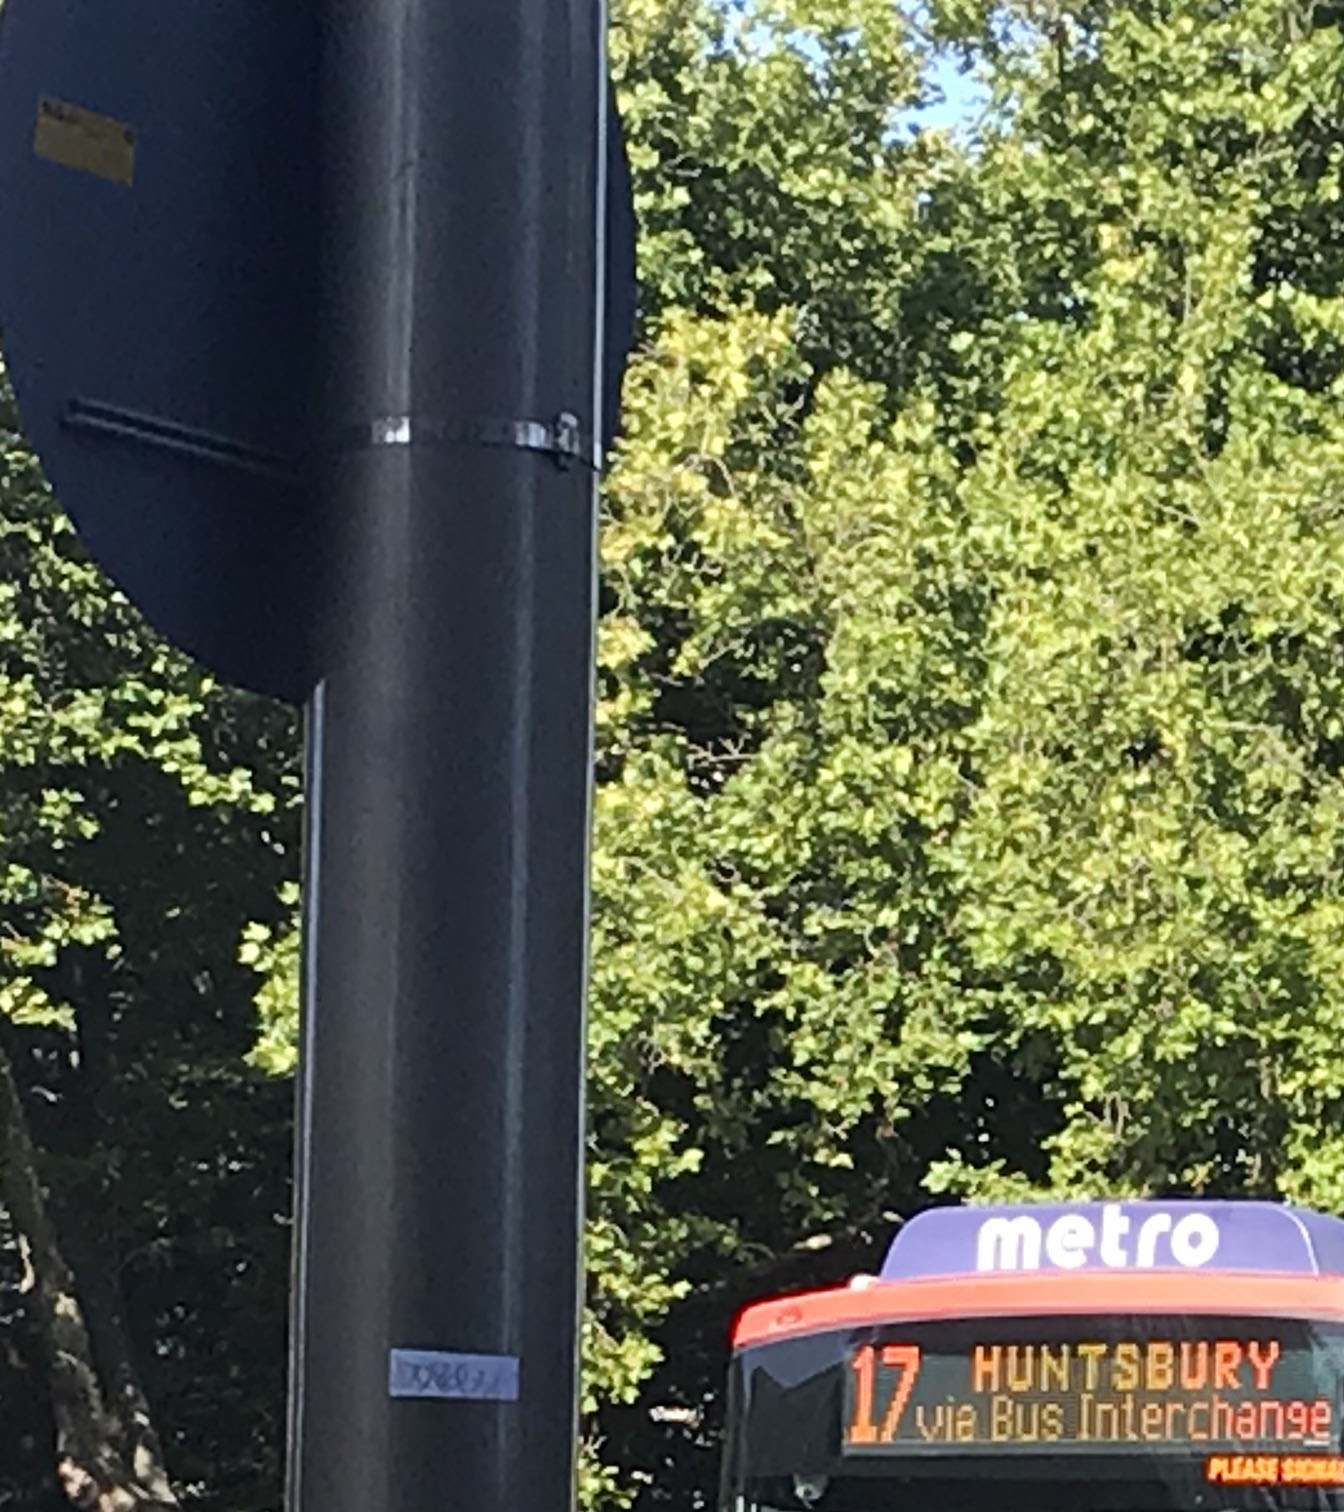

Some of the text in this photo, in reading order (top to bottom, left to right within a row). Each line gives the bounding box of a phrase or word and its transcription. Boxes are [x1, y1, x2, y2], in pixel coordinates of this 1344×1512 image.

[977, 1204, 1219, 1272] metro
[972, 1341, 1279, 1392] HUNTSBURY
[851, 1345, 920, 1442] 17
[915, 1394, 1332, 1442] via Bus Interchange
[1208, 1456, 1278, 1483] PLEASE
